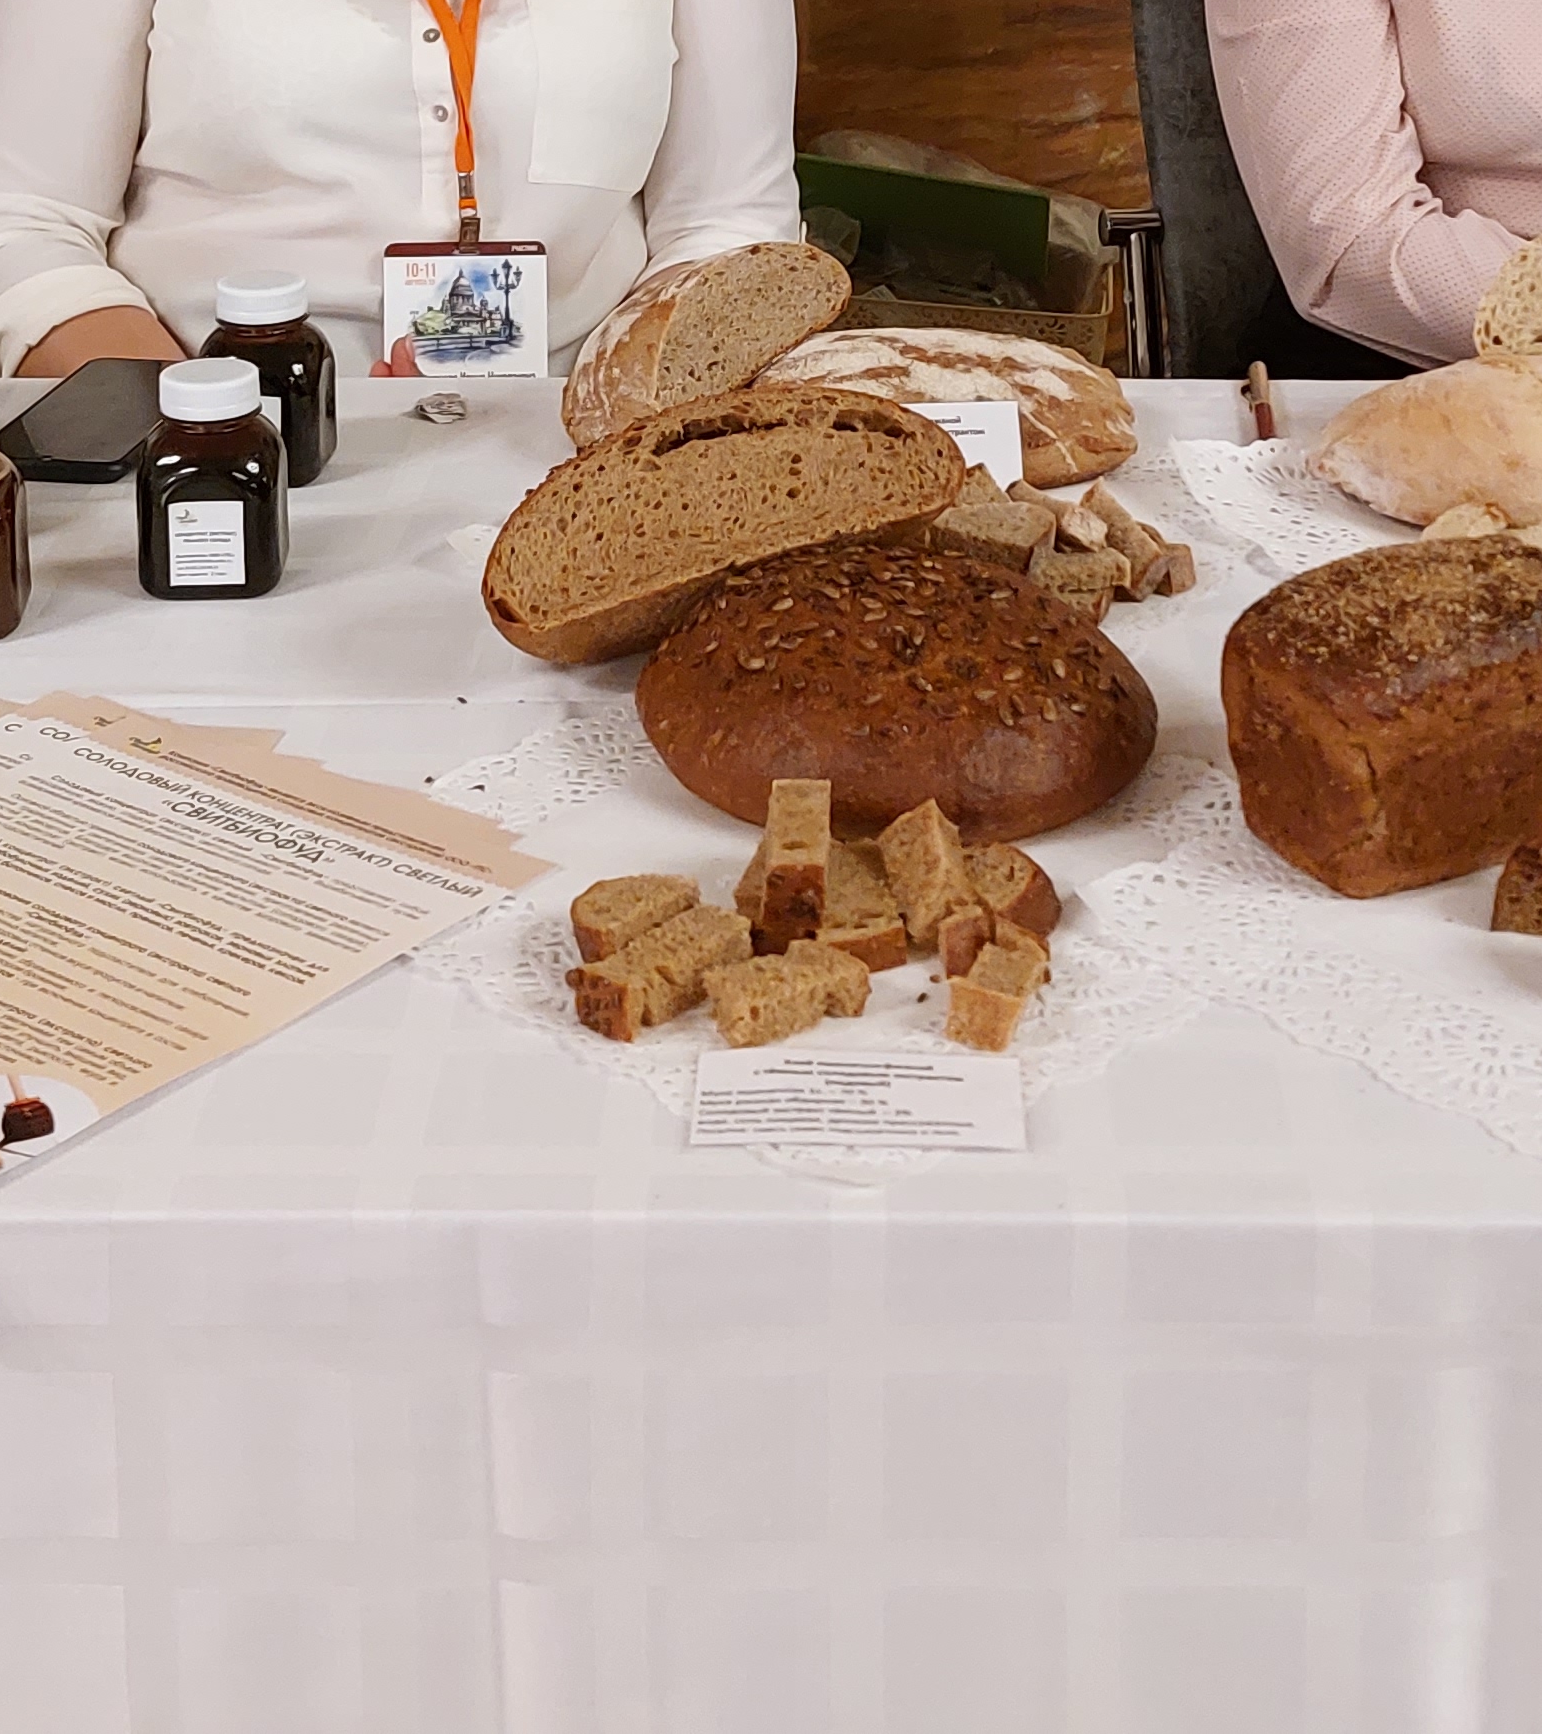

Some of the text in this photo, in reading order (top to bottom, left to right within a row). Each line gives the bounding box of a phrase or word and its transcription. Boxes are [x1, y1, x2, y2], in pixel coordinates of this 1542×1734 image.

[73, 747, 192, 795] СОЛОДОВЫЙ
[188, 790, 294, 832] КОНЦЕНТРАТ
[290, 823, 393, 868] (ЭКСТРАКТ)
[393, 863, 484, 898] СВЕТЛЫЙ
[161, 799, 336, 864] «СВИТБИОФУД»
